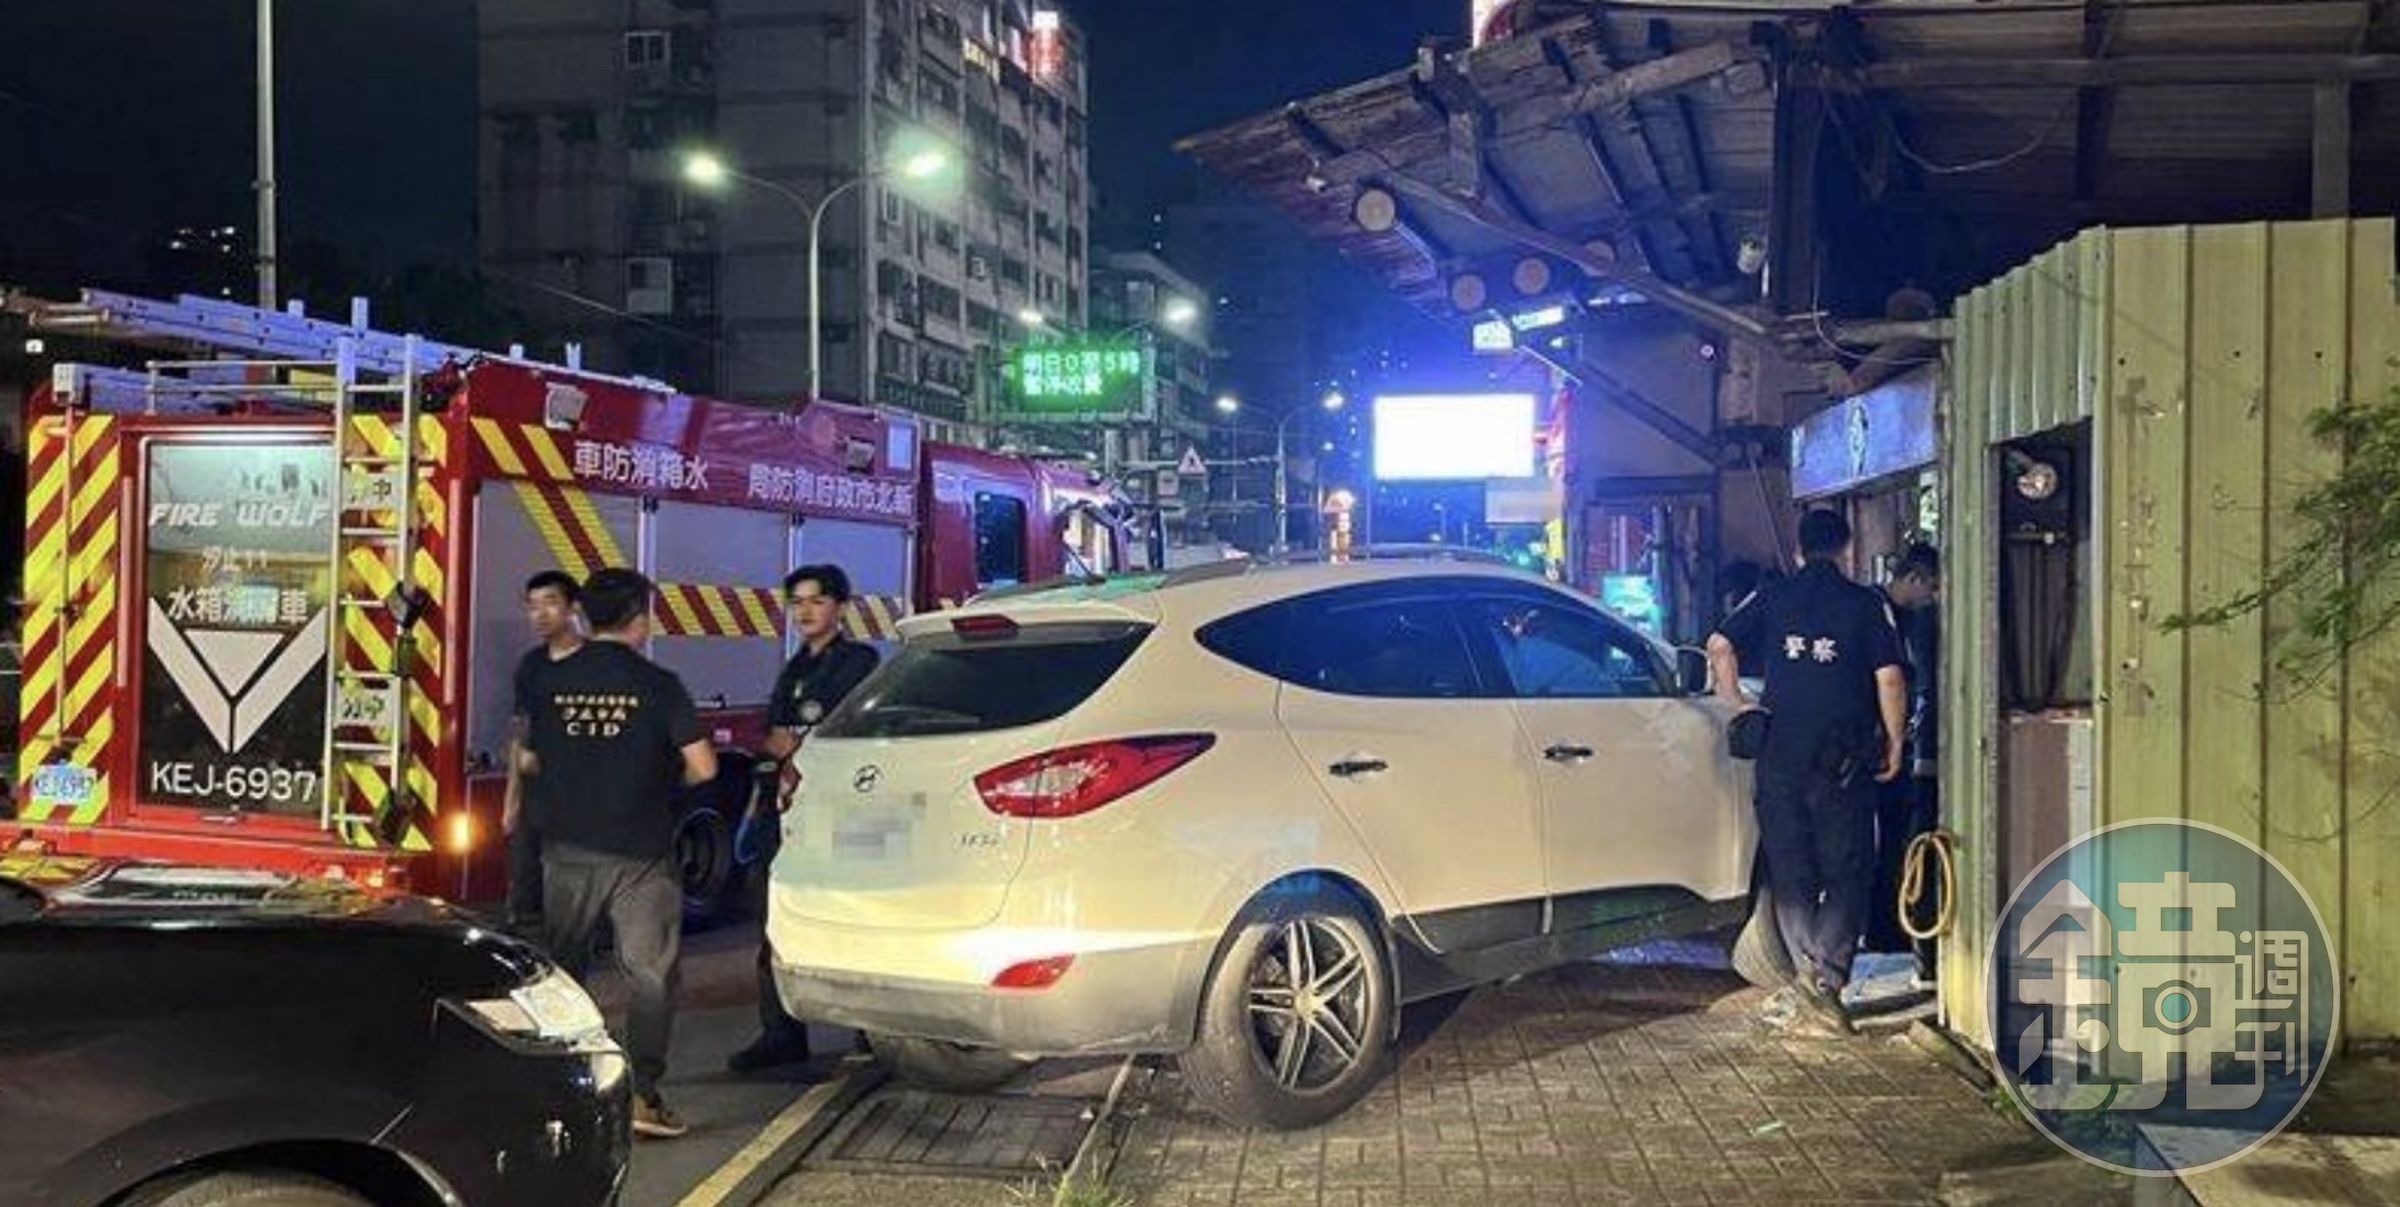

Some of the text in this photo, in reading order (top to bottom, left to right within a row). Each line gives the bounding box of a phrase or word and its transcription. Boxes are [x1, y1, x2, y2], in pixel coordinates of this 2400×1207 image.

[149, 502, 332, 527] FIRE WOLF
[1783, 634, 1839, 663] 警察
[566, 721, 620, 736] CID
[151, 761, 317, 803] KEJ-6937
